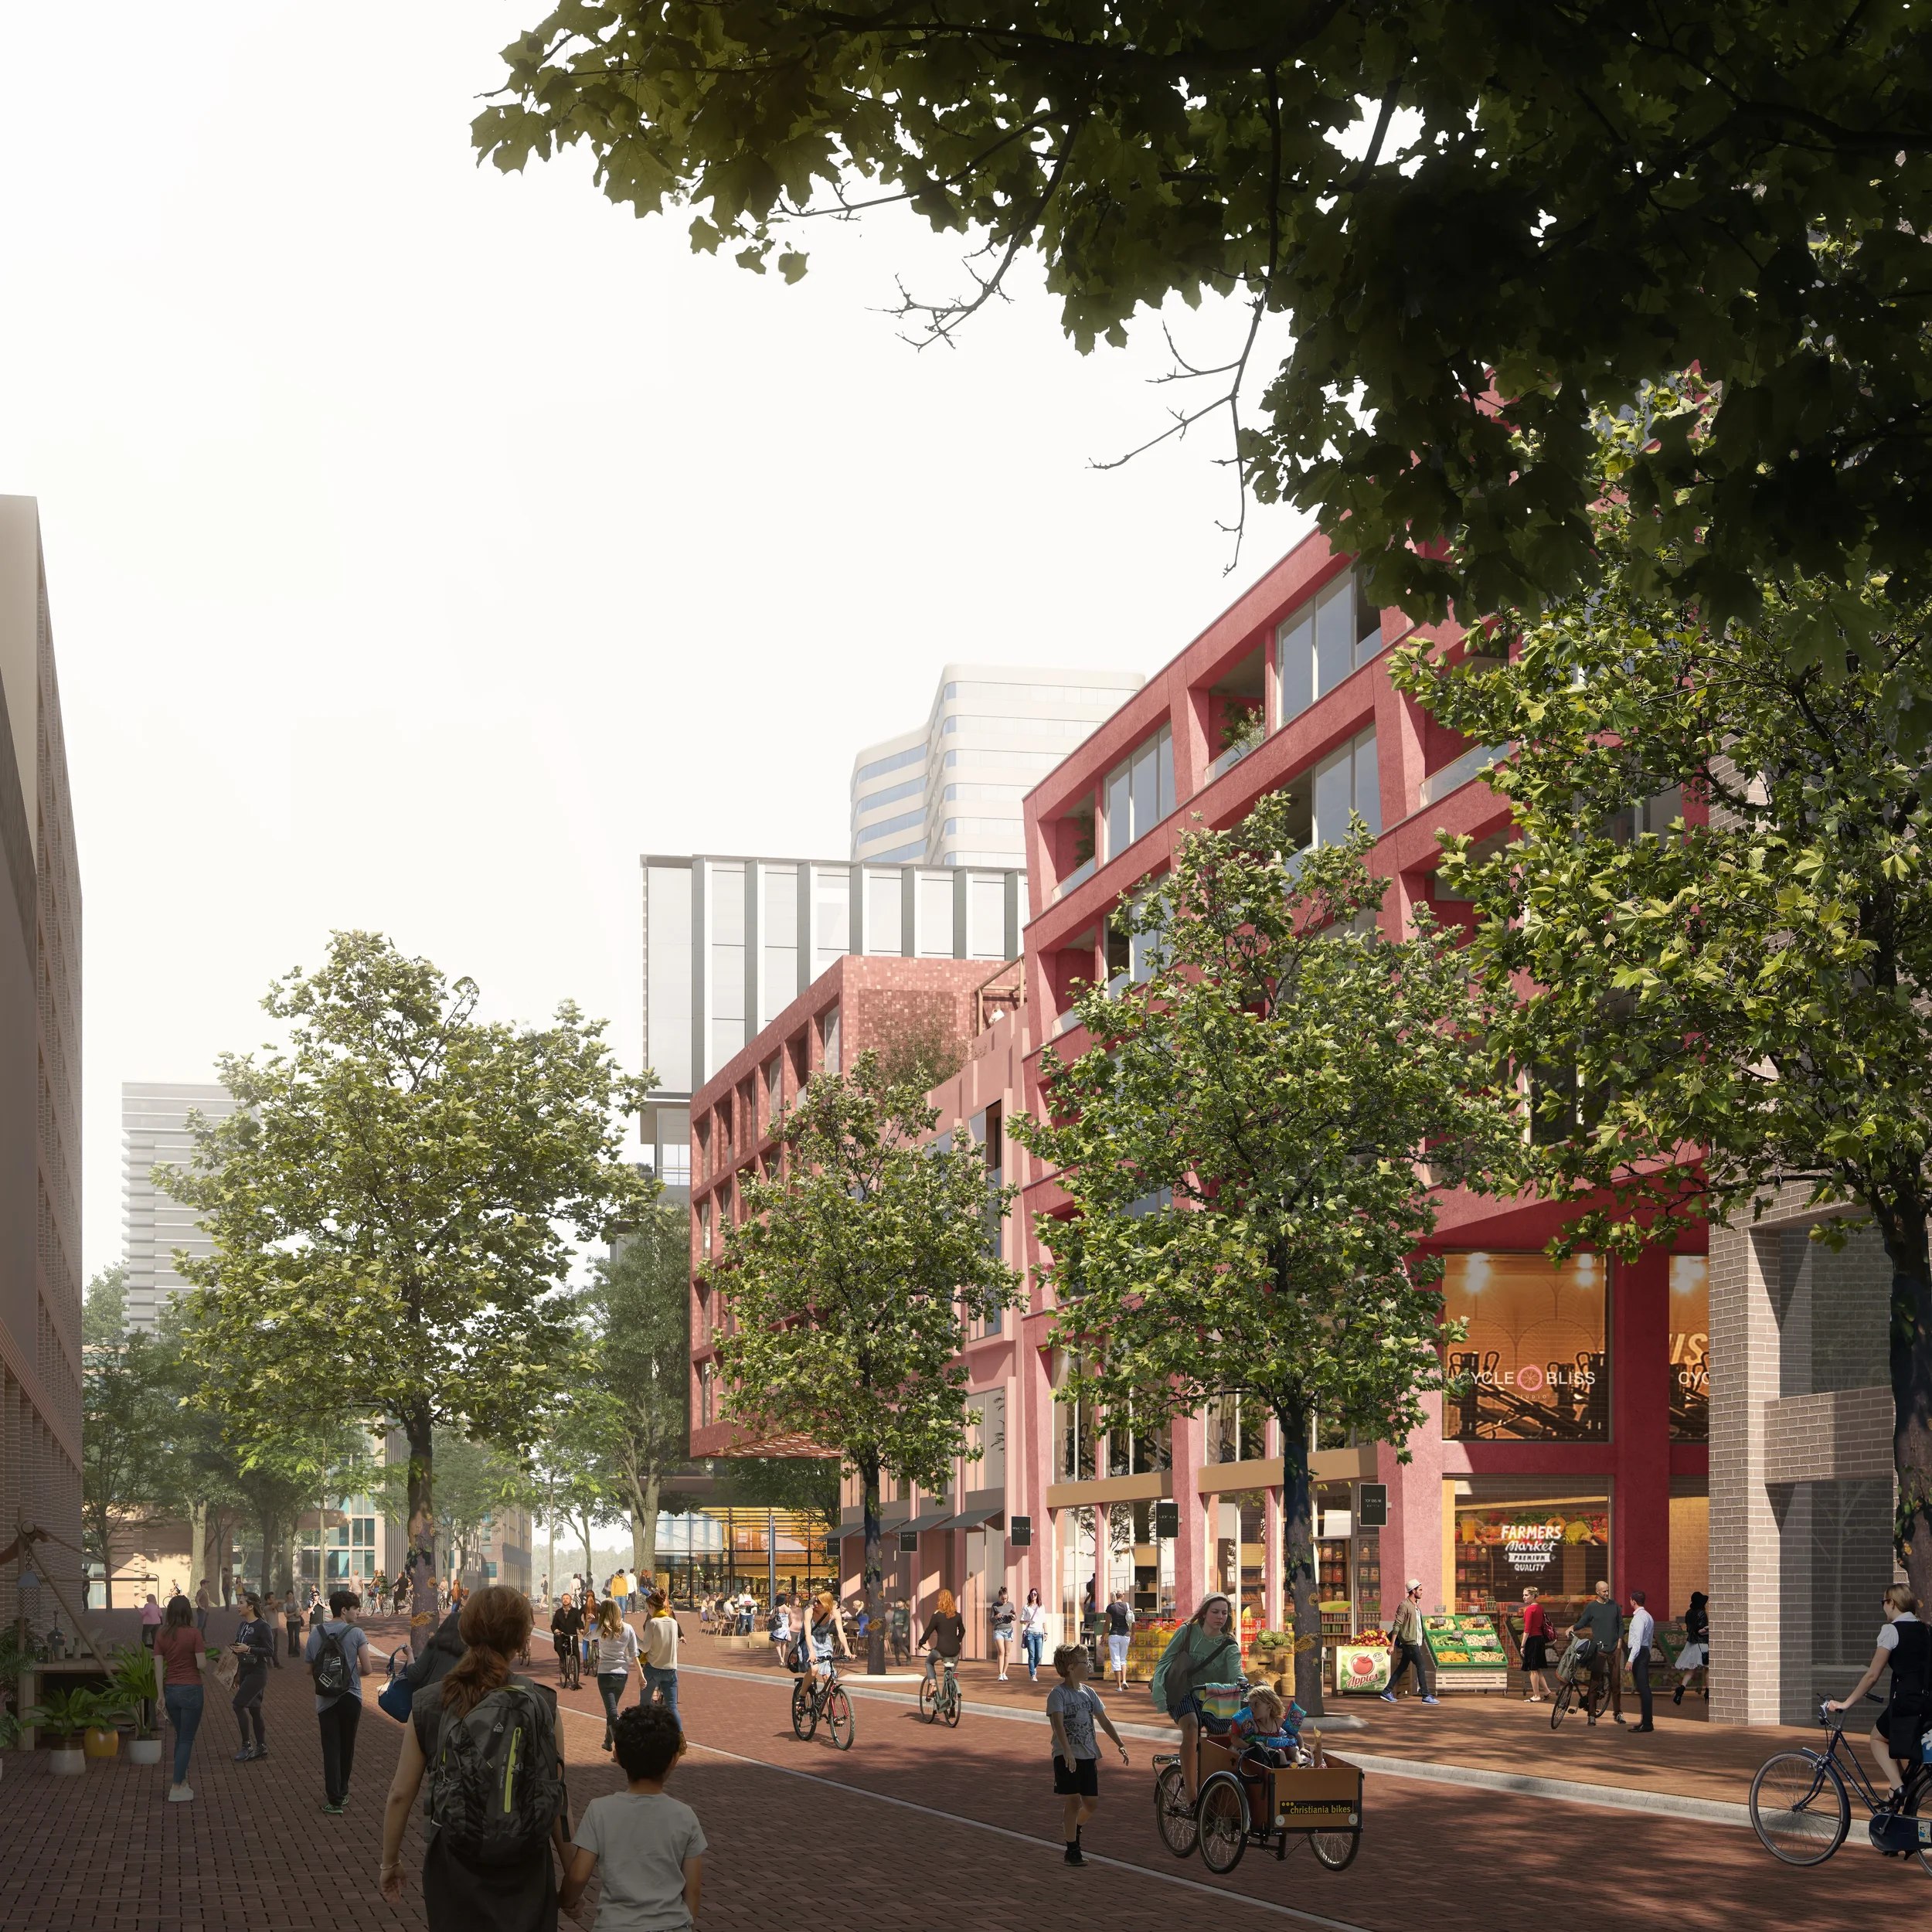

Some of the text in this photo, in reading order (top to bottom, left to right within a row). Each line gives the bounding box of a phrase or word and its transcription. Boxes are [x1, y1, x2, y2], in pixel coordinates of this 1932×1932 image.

[1546, 1371, 1596, 1385] BLISS
[1501, 1526, 1562, 1539] FARMERS
[1505, 1540, 1559, 1552] Market
[1514, 1563, 1546, 1572] QUALITY
[1346, 1673, 1379, 1689] Apples
[1290, 1804, 1351, 1815] christiania bikes
